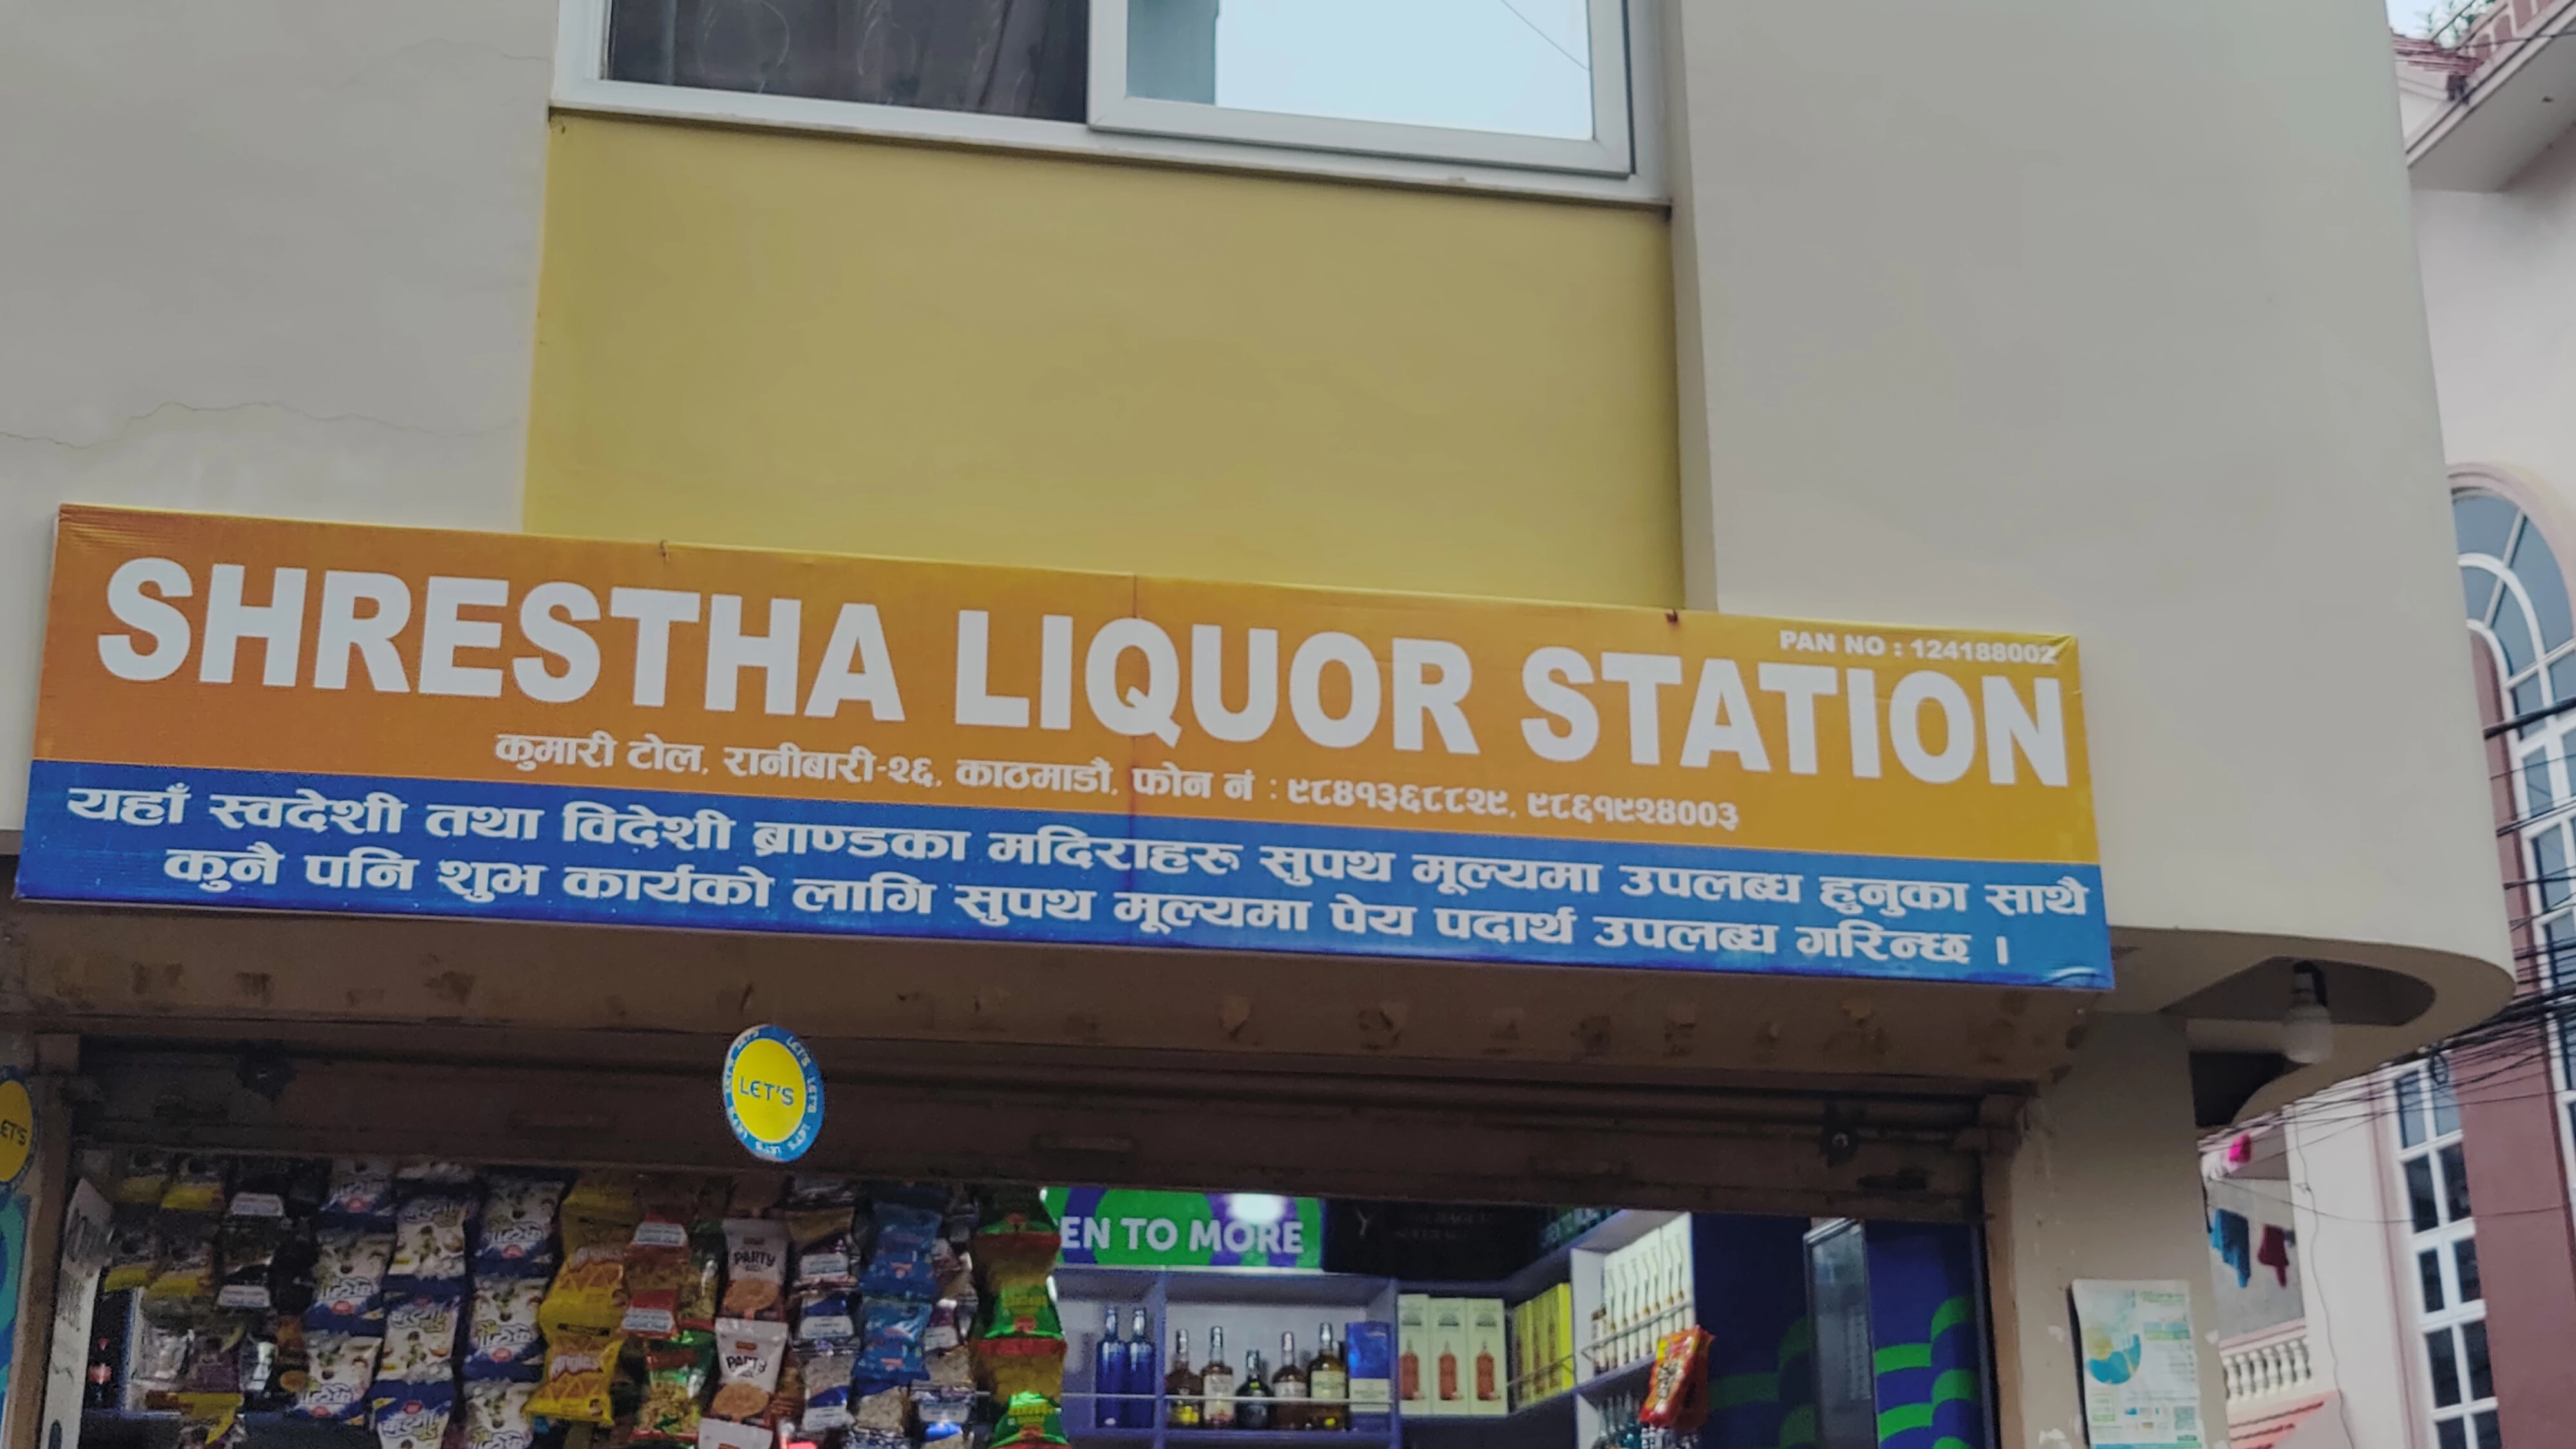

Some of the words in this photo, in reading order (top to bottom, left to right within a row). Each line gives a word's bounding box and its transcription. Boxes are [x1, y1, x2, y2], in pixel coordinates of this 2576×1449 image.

[97, 558, 905, 721] SHRESTHA
[955, 610, 1480, 749] LIQUOR
[1520, 646, 2069, 788] STATION
[1779, 630, 1837, 653] PAN
[1844, 634, 1887, 656] NO
[1910, 638, 2059, 665] 124188002
[495, 730, 618, 772] कुमारी
[1132, 762, 1213, 799] फोन
[1224, 770, 1255, 800] नं
[68, 783, 191, 825] यहाँ
[210, 789, 408, 834] स्वदेशी
[426, 805, 544, 839] तथा
[563, 800, 736, 851] विदेशी
[753, 822, 971, 860] ब्राण्डका
[1260, 846, 1396, 886] सुपथ
[1412, 855, 1603, 895] मूल्यमा
[1619, 866, 1803, 903] उपलब्ध
[1819, 876, 1969, 917] हुनुका
[1985, 876, 2089, 915] साथै
[165, 846, 284, 892] कुनै
[304, 847, 420, 889] पनि
[439, 861, 546, 902] शुभ
[564, 864, 775, 907] कार्यको
[793, 872, 937, 914] लागि
[954, 886, 1097, 926] सुपथ
[1114, 895, 1312, 934] मूल्यमा
[1329, 894, 1417, 936] पेय
[1434, 907, 1577, 944] पदार्थ
[1593, 917, 1779, 953] उपलब्ध
[1795, 919, 1971, 963] गरिन्छ
[739, 1076, 795, 1106] LET'S
[0, 1119, 27, 1146] ET'S
[1061, 1217, 1109, 1249] EN
[1121, 1218, 1177, 1250] TO
[1190, 1220, 1303, 1254] MORE
